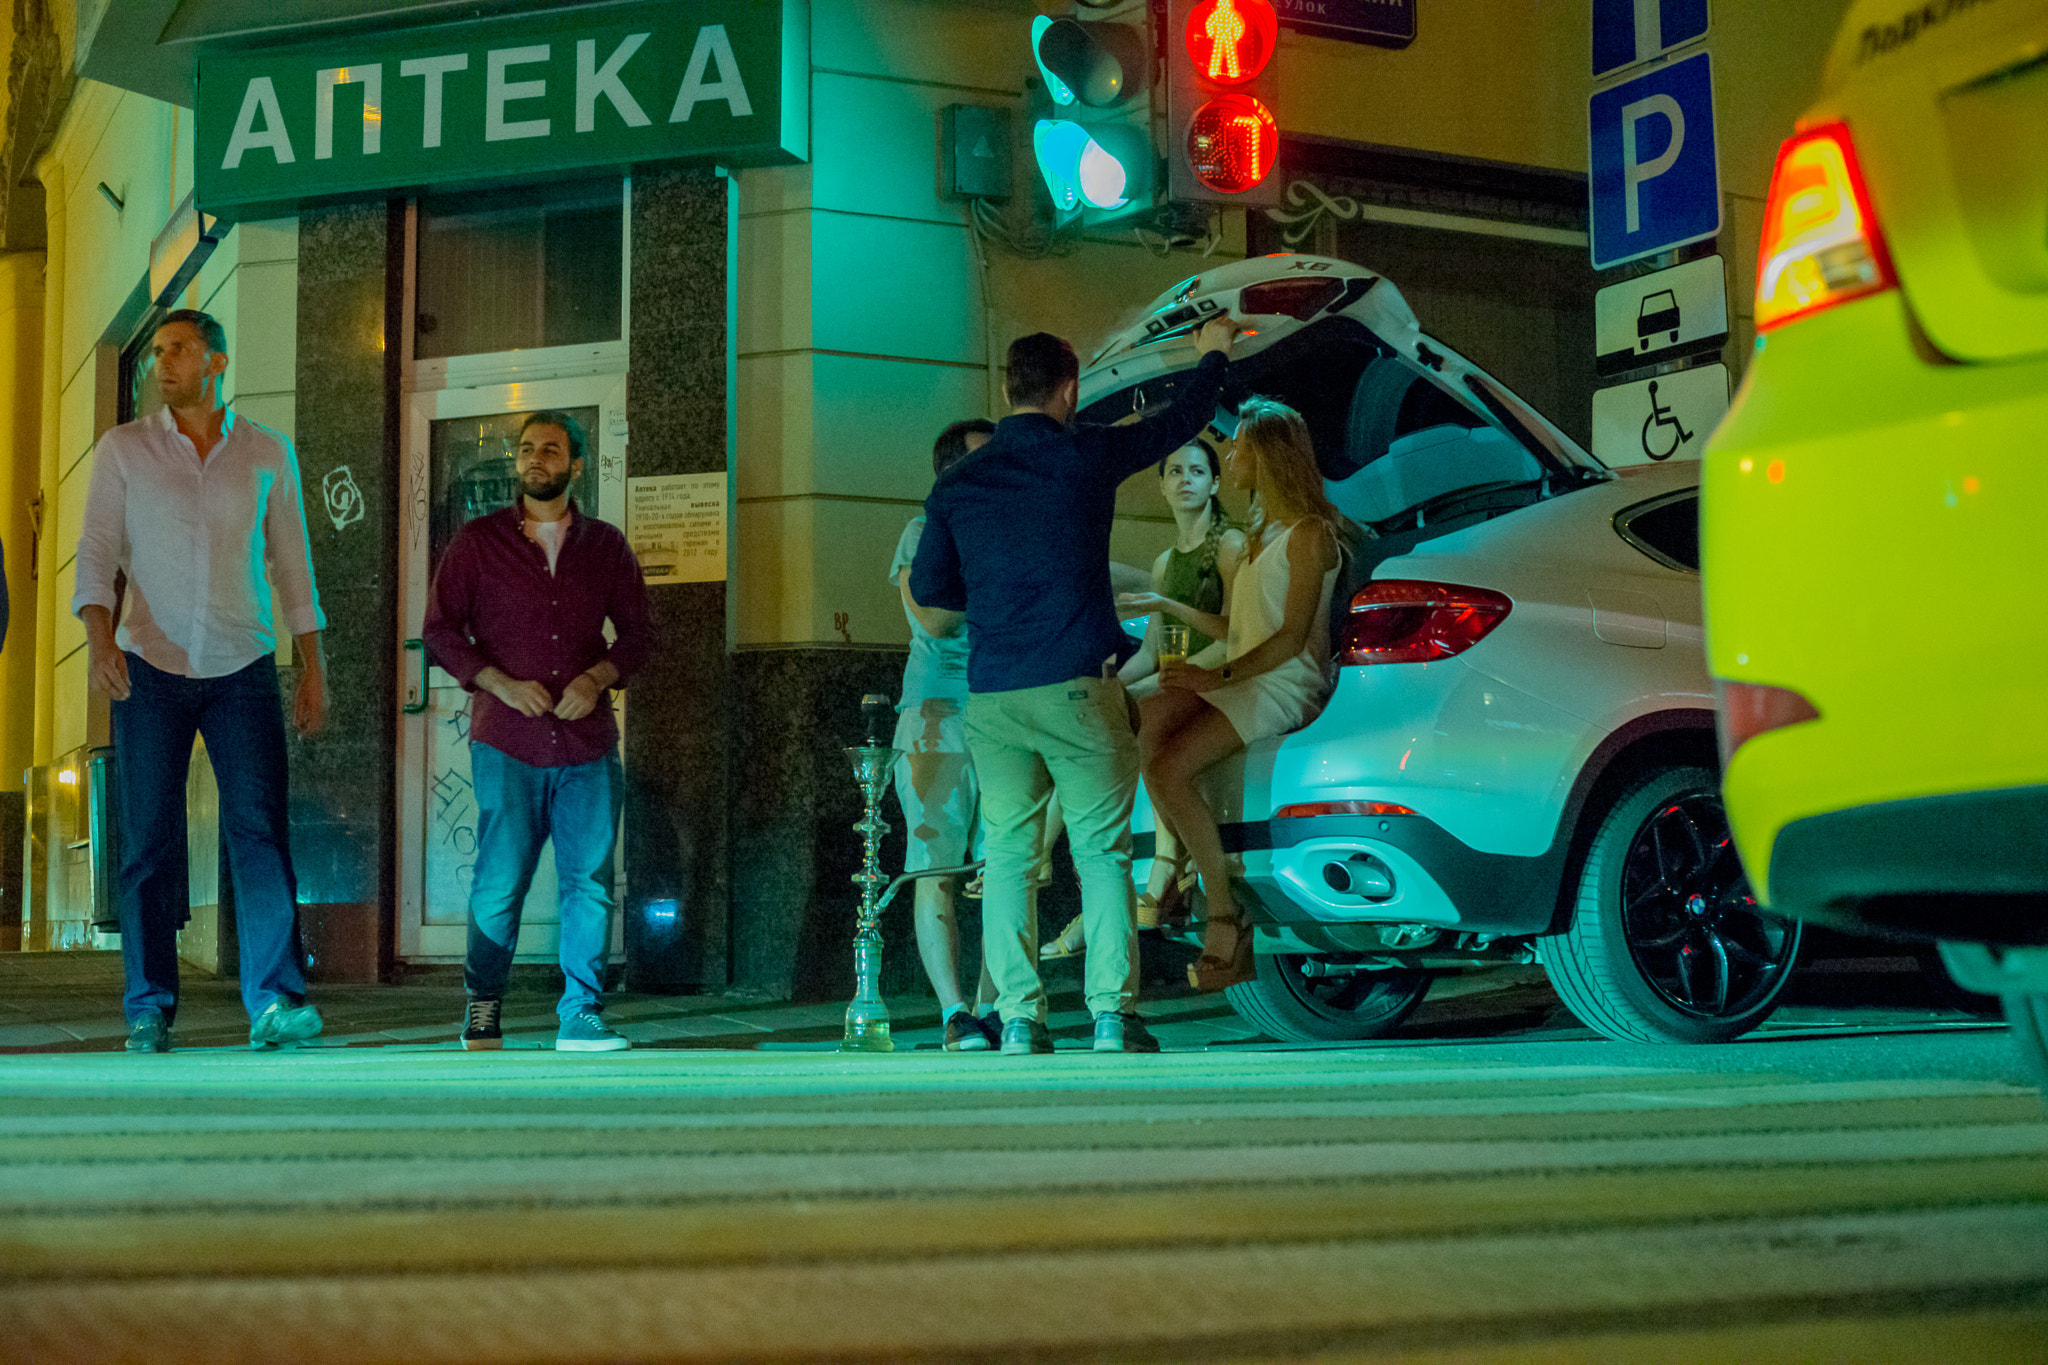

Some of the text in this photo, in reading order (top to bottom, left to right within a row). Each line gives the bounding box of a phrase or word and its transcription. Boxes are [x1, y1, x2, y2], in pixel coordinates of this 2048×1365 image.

[221, 24, 753, 170] АПТЕКА
[1622, 94, 1686, 234] P
[1286, 261, 1333, 272] X6
[683, 530, 719, 538] средствами
